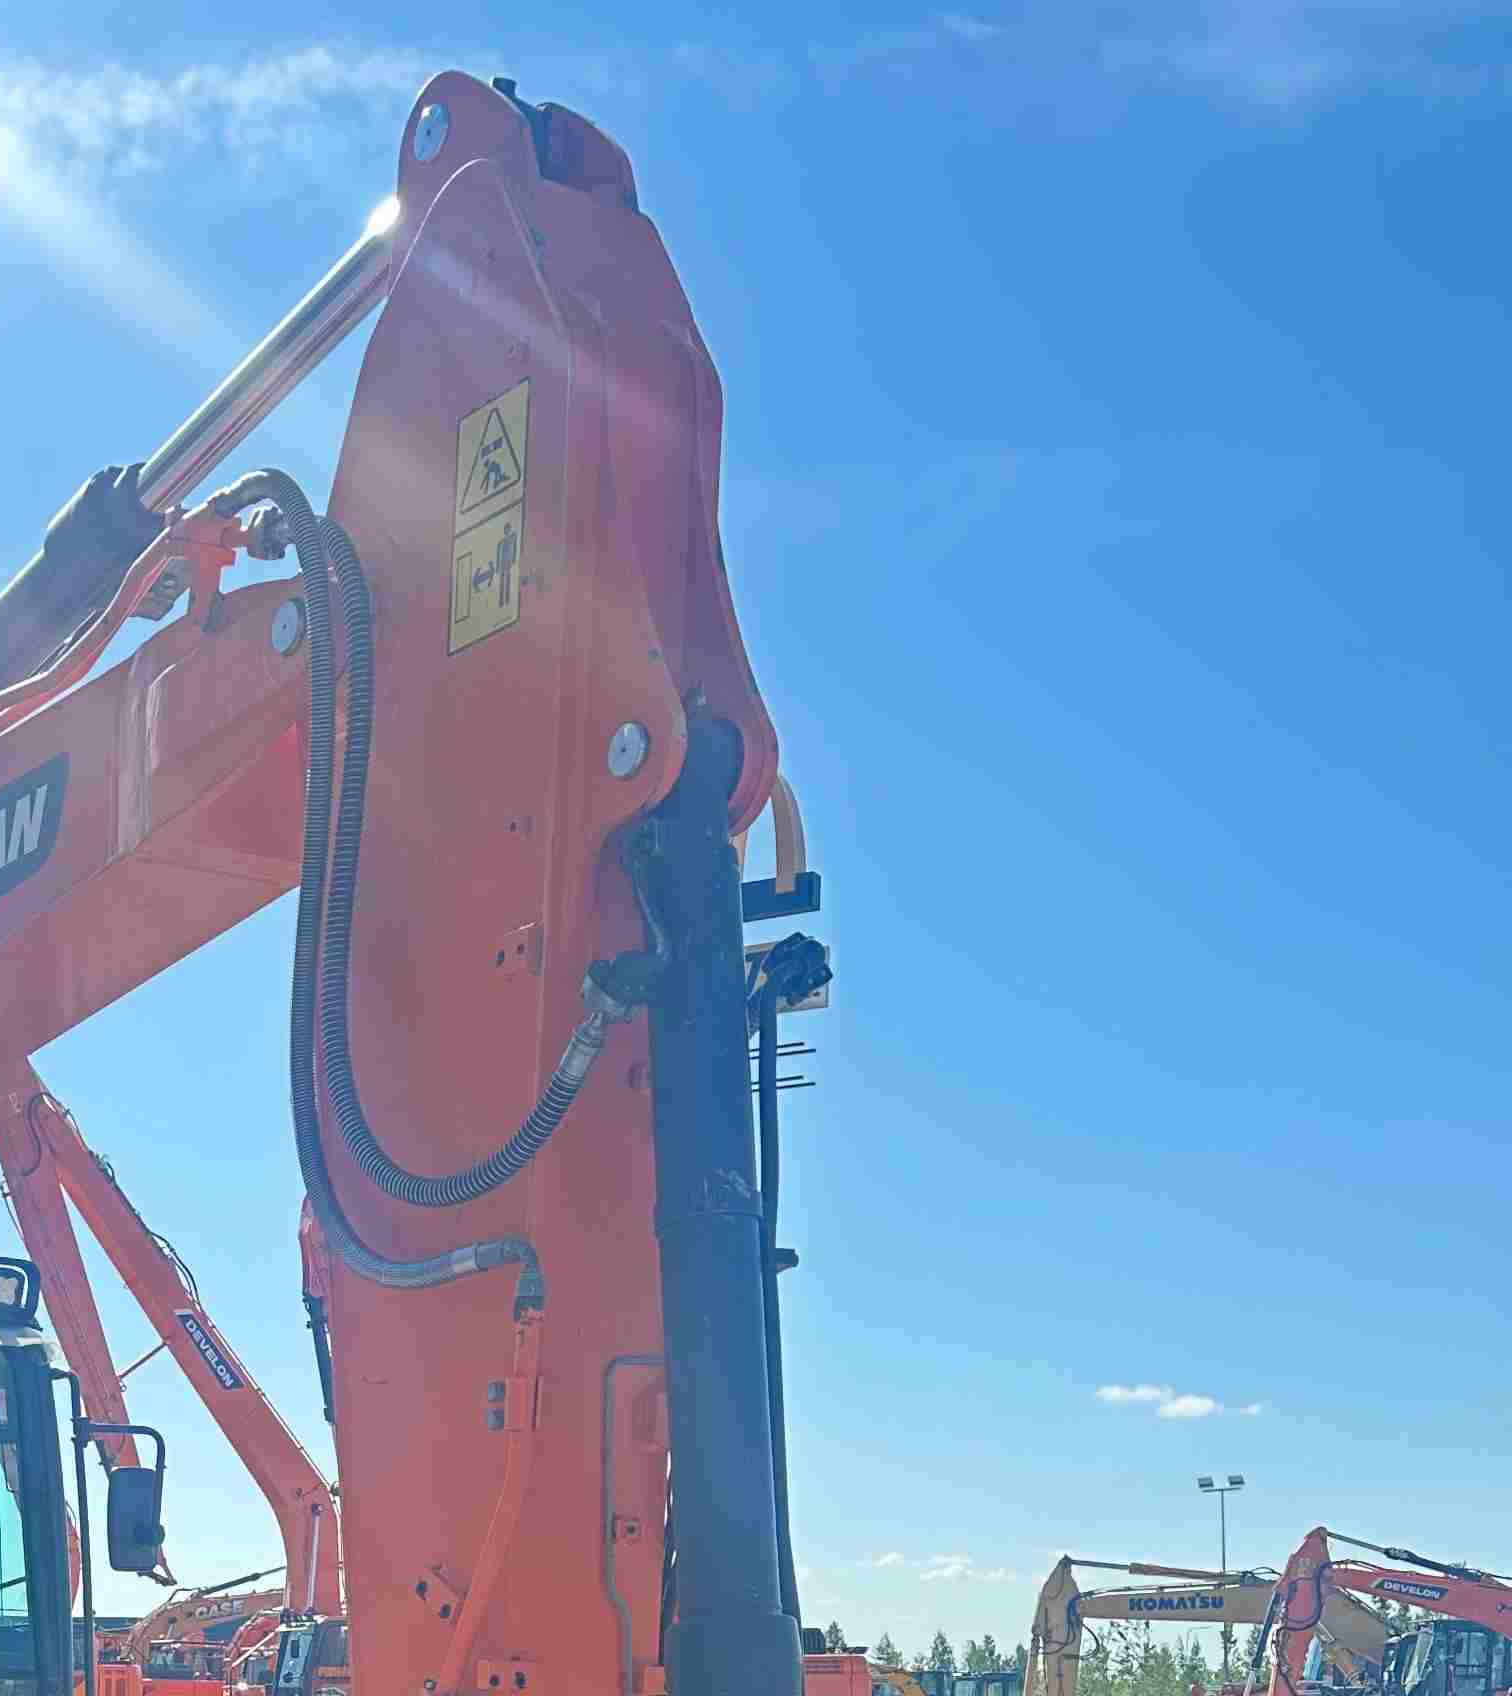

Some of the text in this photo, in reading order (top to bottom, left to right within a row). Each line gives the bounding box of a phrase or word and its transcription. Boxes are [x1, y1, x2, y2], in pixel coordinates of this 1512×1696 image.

[185, 1319, 234, 1387] DEVELON
[1383, 1581, 1441, 1600] DEVELON
[194, 1600, 245, 1618] CASE
[1128, 1592, 1225, 1611] KOMATSU
